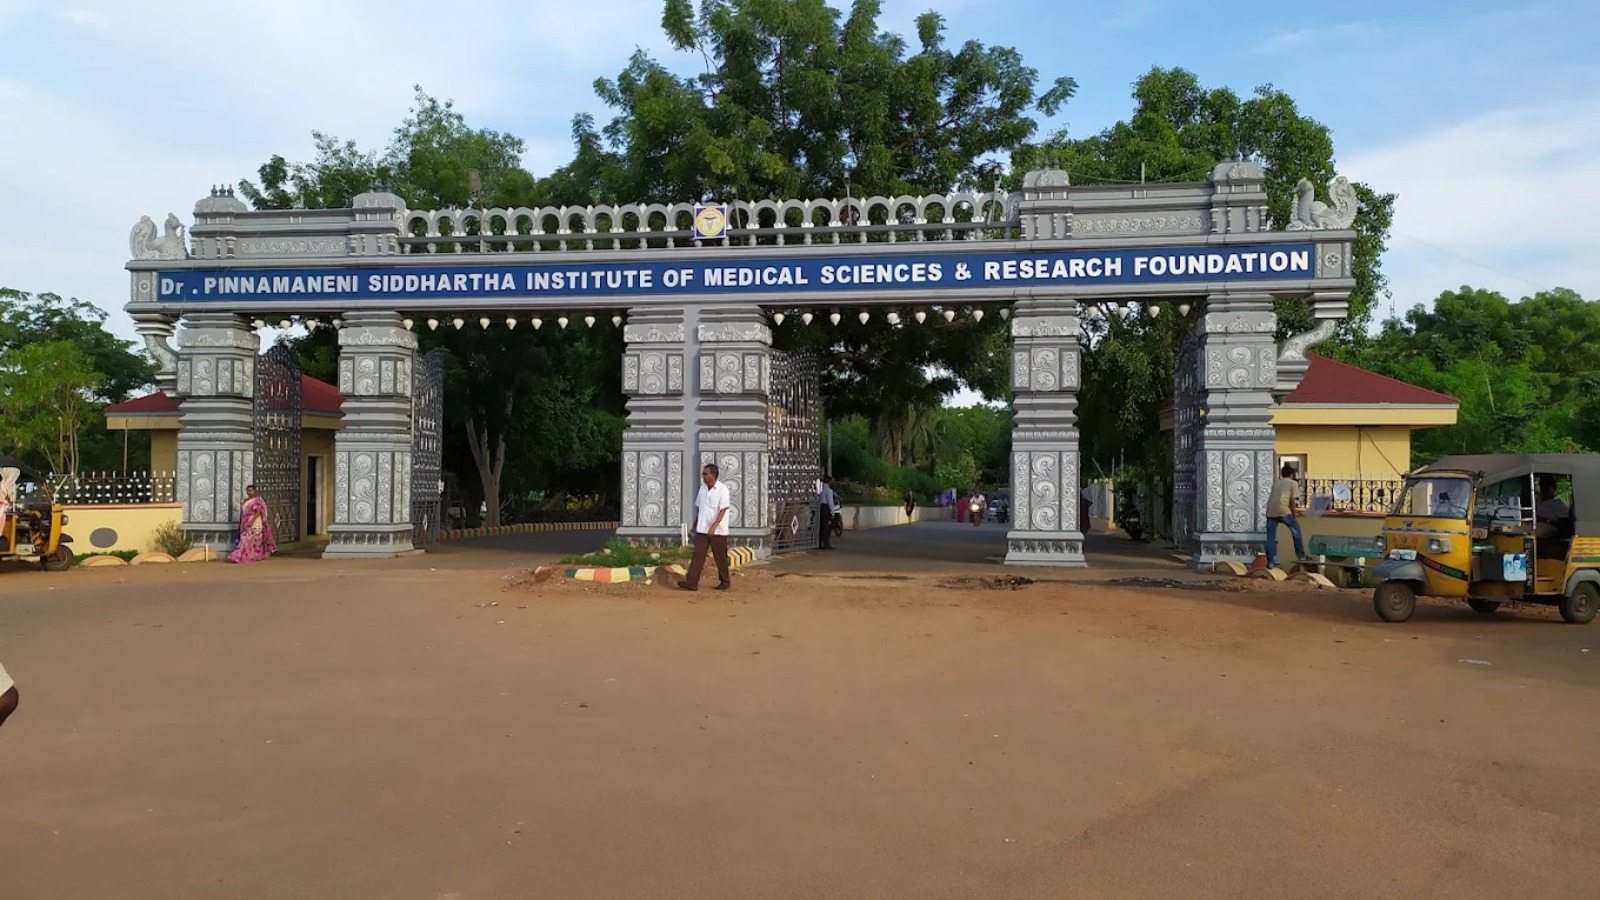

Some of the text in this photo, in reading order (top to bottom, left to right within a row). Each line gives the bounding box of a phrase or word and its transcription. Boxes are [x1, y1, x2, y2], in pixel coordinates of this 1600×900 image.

[204, 275, 358, 294] PINNAMANENI
[368, 273, 516, 292] SIDDHARTHA
[527, 269, 653, 290] INSTITUTE
[663, 269, 694, 288] OF
[704, 266, 809, 287] MEDICAL
[820, 263, 943, 284] SCIENCES
[954, 262, 972, 281] &
[984, 257, 1122, 280] RESEARCH
[1134, 250, 1309, 276] FOUNDATION
